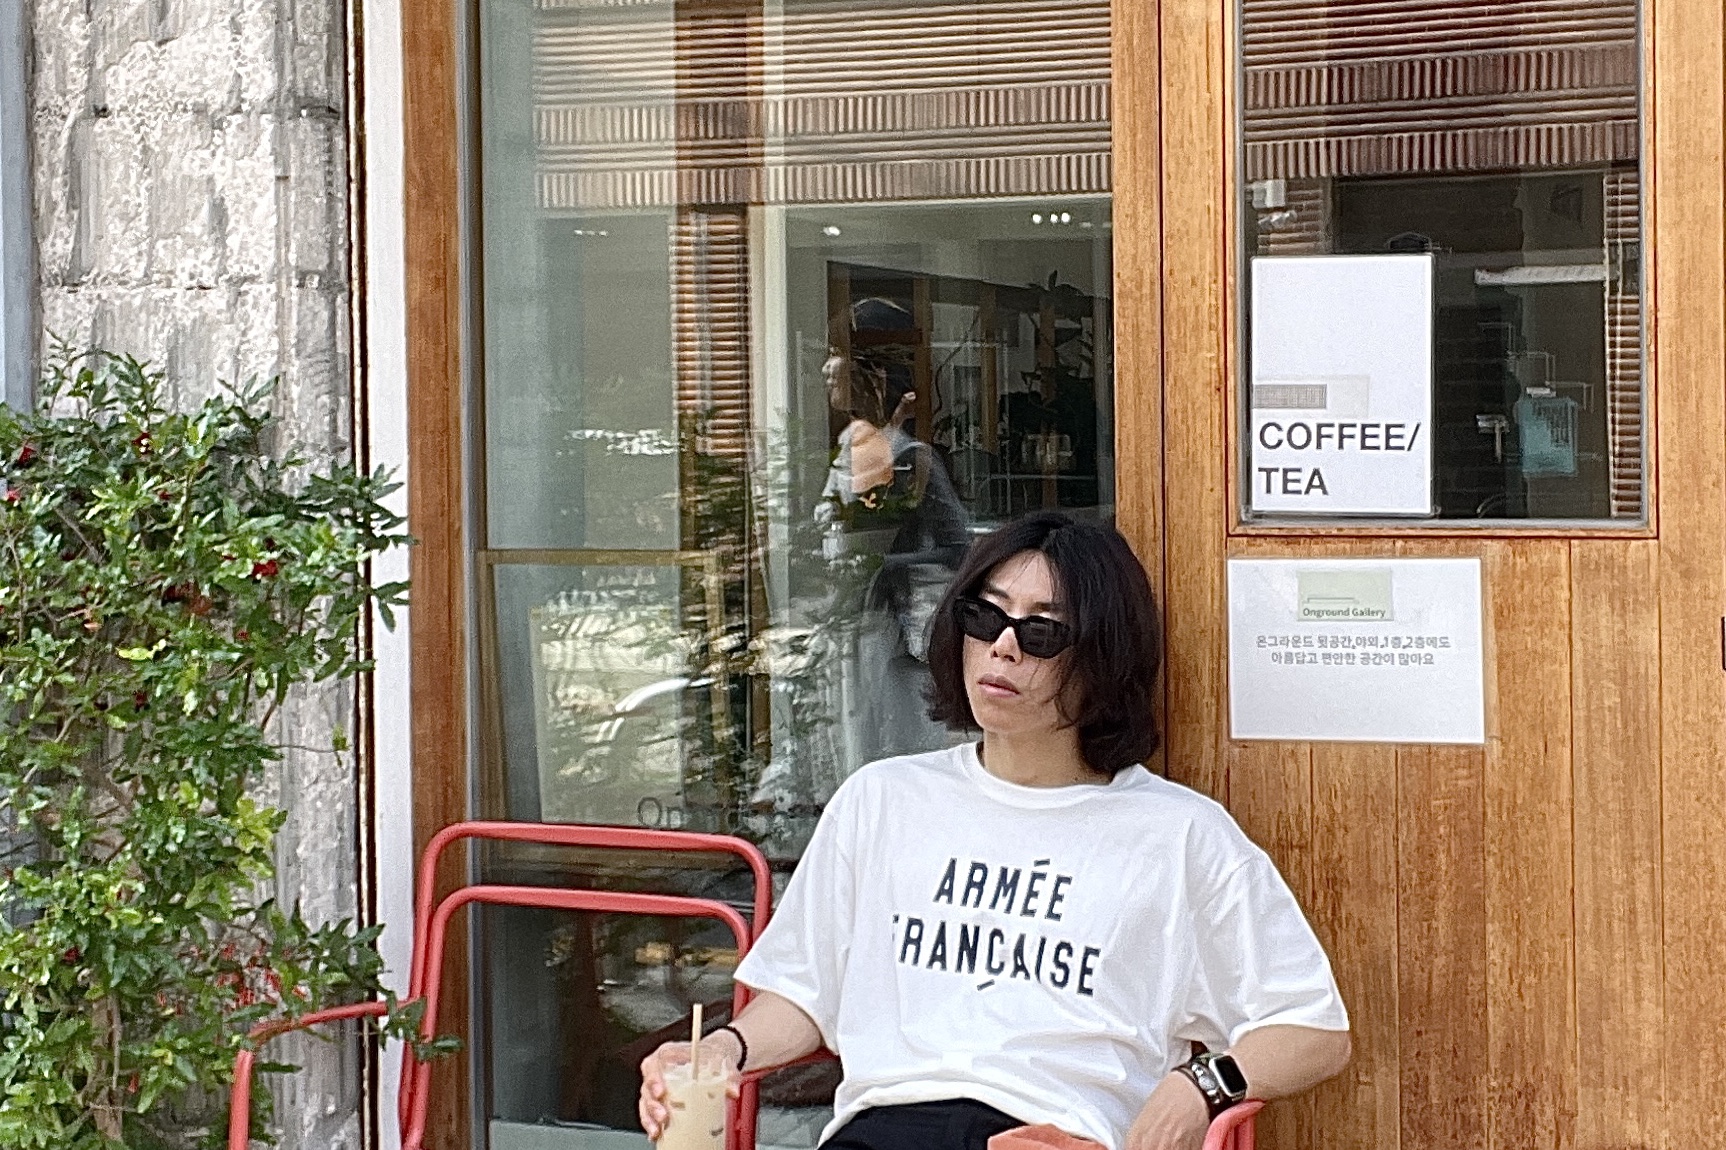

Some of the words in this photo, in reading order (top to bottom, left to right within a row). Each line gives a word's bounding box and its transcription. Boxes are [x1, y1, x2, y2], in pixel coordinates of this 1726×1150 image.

[1259, 421, 1422, 452] COFFEE/
[1257, 467, 1329, 496] TEA
[1302, 607, 1350, 618] Onground
[932, 857, 1073, 922] ARMÉE
